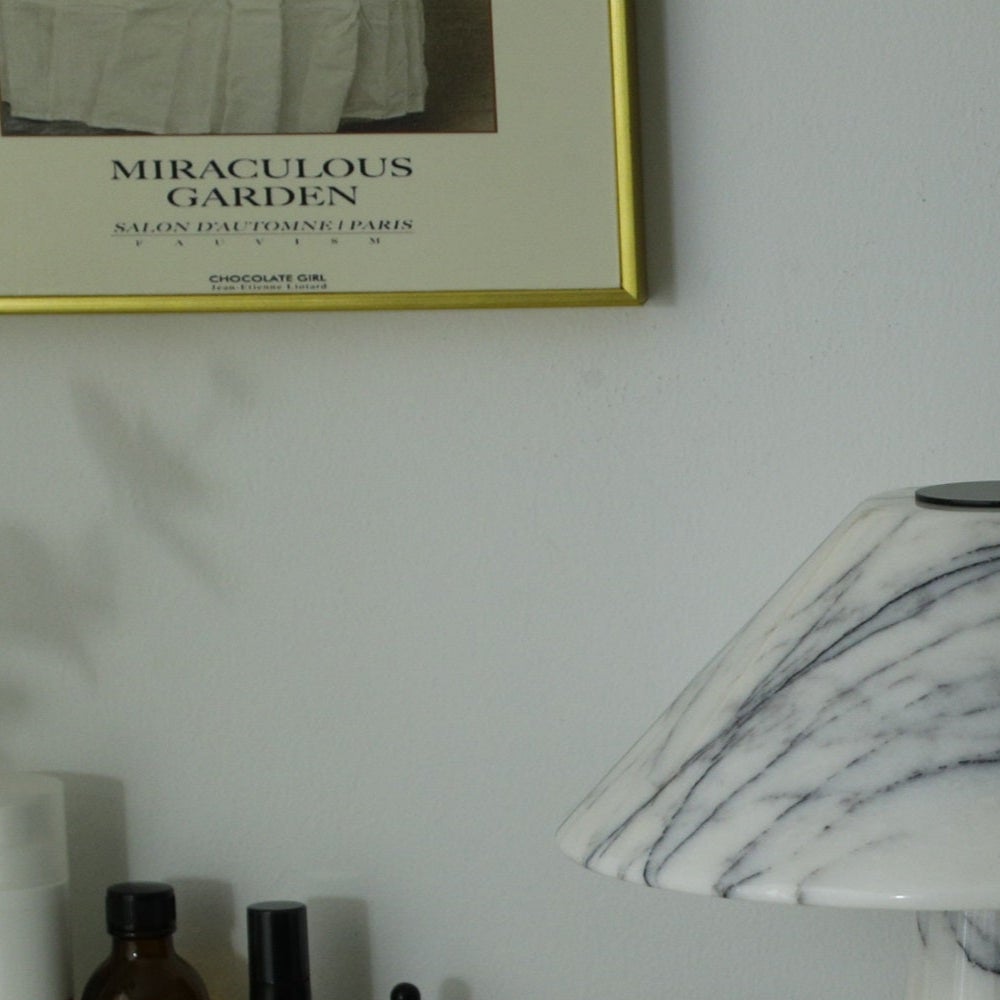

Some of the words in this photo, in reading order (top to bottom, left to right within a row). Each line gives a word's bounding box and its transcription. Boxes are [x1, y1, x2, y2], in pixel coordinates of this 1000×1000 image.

[111, 157, 413, 180] MIRACULOUS
[167, 185, 358, 207] GARDEN
[114, 221, 191, 233] SALON
[197, 220, 333, 232] D'AUTOMNE
[349, 218, 414, 231] PARIS
[209, 274, 293, 283] CHOCOLATE
[296, 273, 327, 282] GIRL
